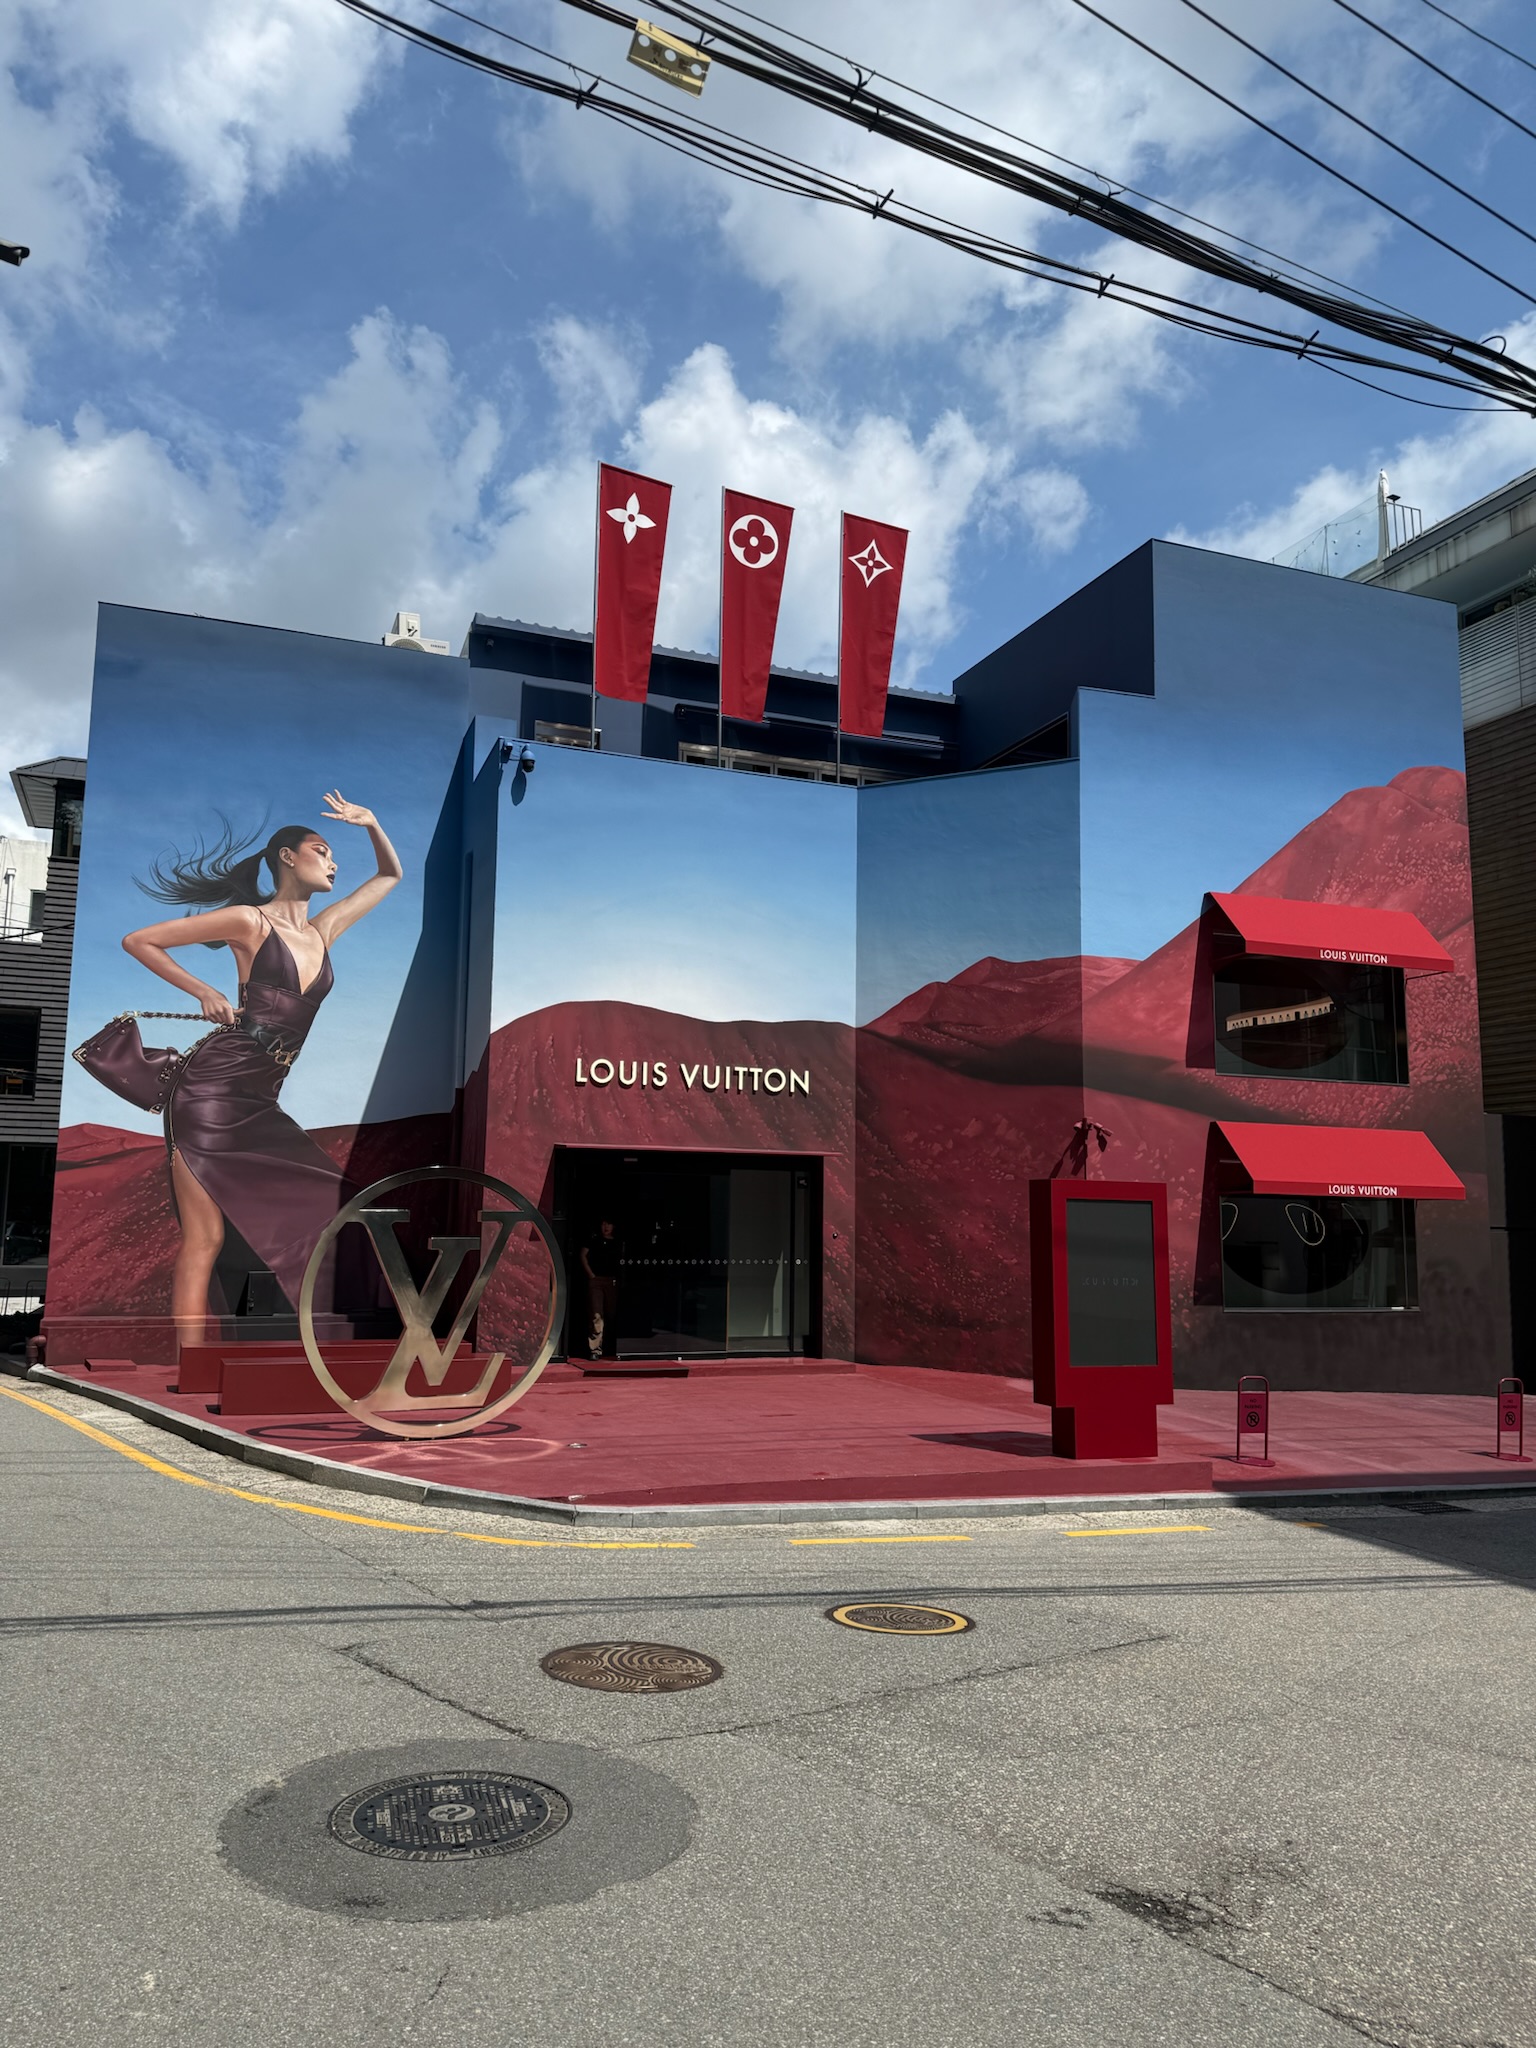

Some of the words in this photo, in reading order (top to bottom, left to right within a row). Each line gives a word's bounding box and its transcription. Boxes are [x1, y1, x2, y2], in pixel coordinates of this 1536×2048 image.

[1320, 949, 1347, 961] LOUIS
[1349, 952, 1388, 964] VUITTON
[575, 1057, 668, 1087] LOUIS
[680, 1063, 810, 1095] VUITTON
[1328, 1184, 1355, 1195] LOUIS
[1358, 1185, 1398, 1196] VUITTON
